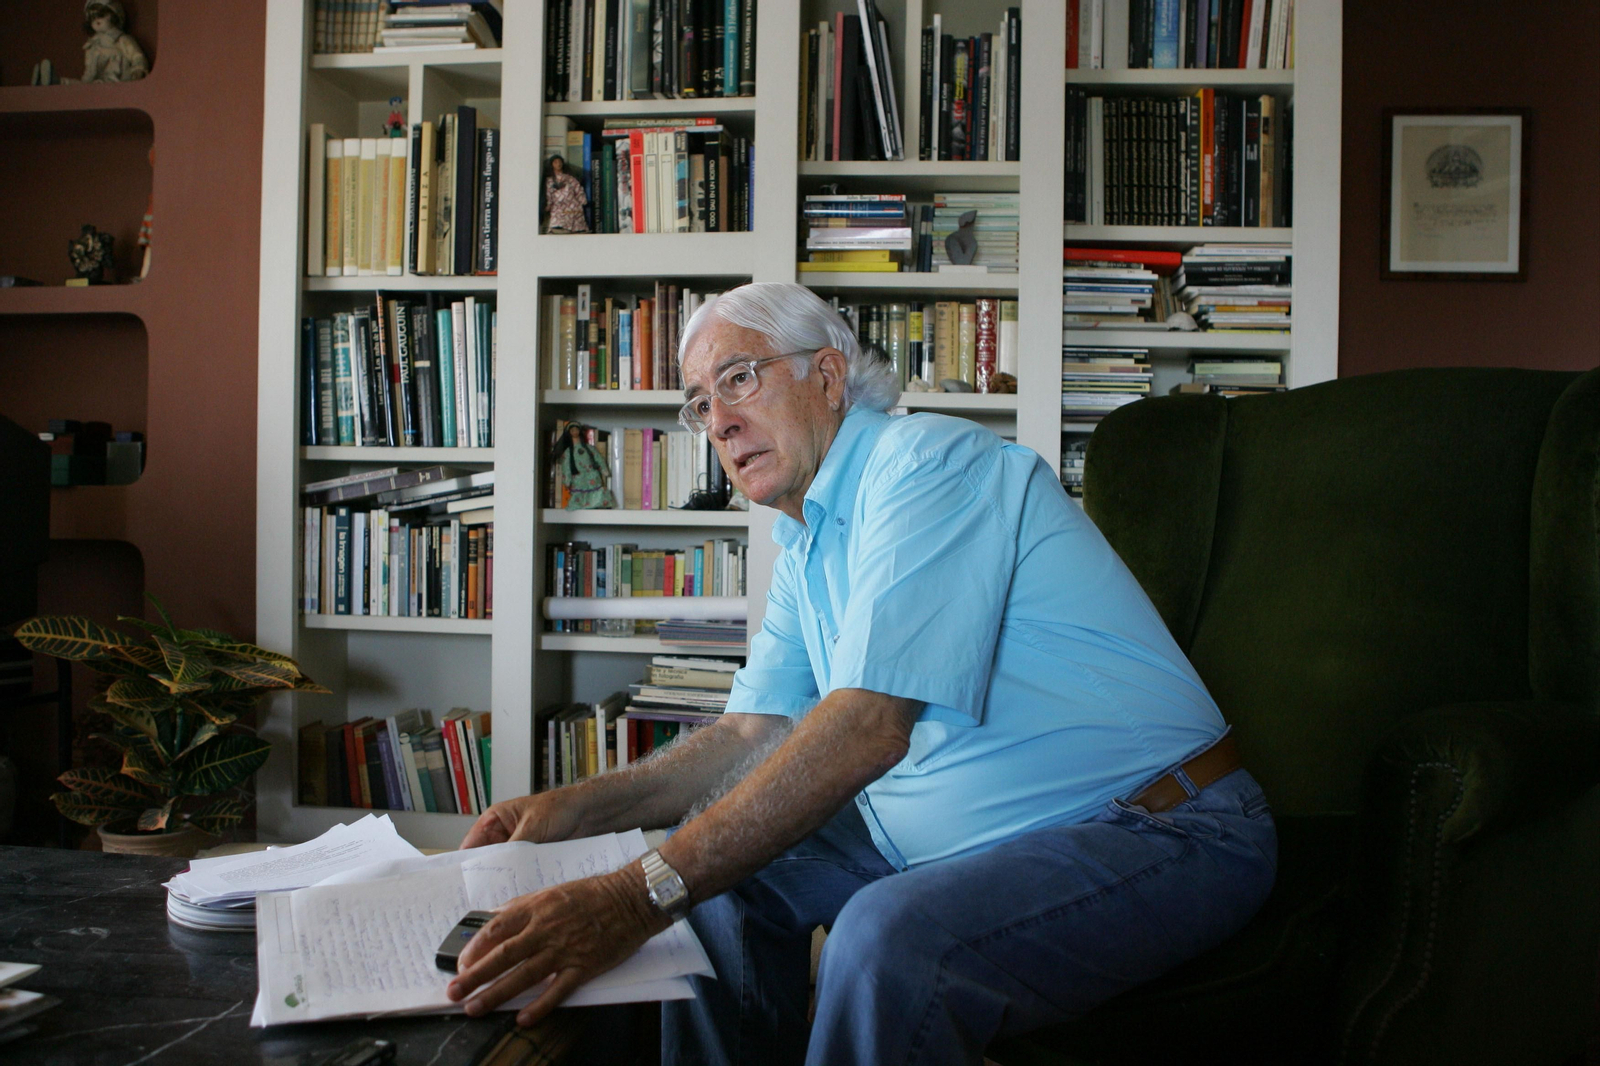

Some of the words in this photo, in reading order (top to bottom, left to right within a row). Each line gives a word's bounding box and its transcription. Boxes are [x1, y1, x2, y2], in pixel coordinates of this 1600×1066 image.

[483, 130, 492, 147] aire
[482, 151, 495, 177] fuego
[484, 181, 494, 203] agua
[483, 208, 491, 234] tierra
[482, 239, 493, 270] españa
[319, 327, 331, 361] MUNDO
[396, 306, 408, 356] GAUGUIN
[321, 368, 331, 383] DEL
[399, 358, 410, 383] PAUL
[321, 390, 333, 428] NOMADA
